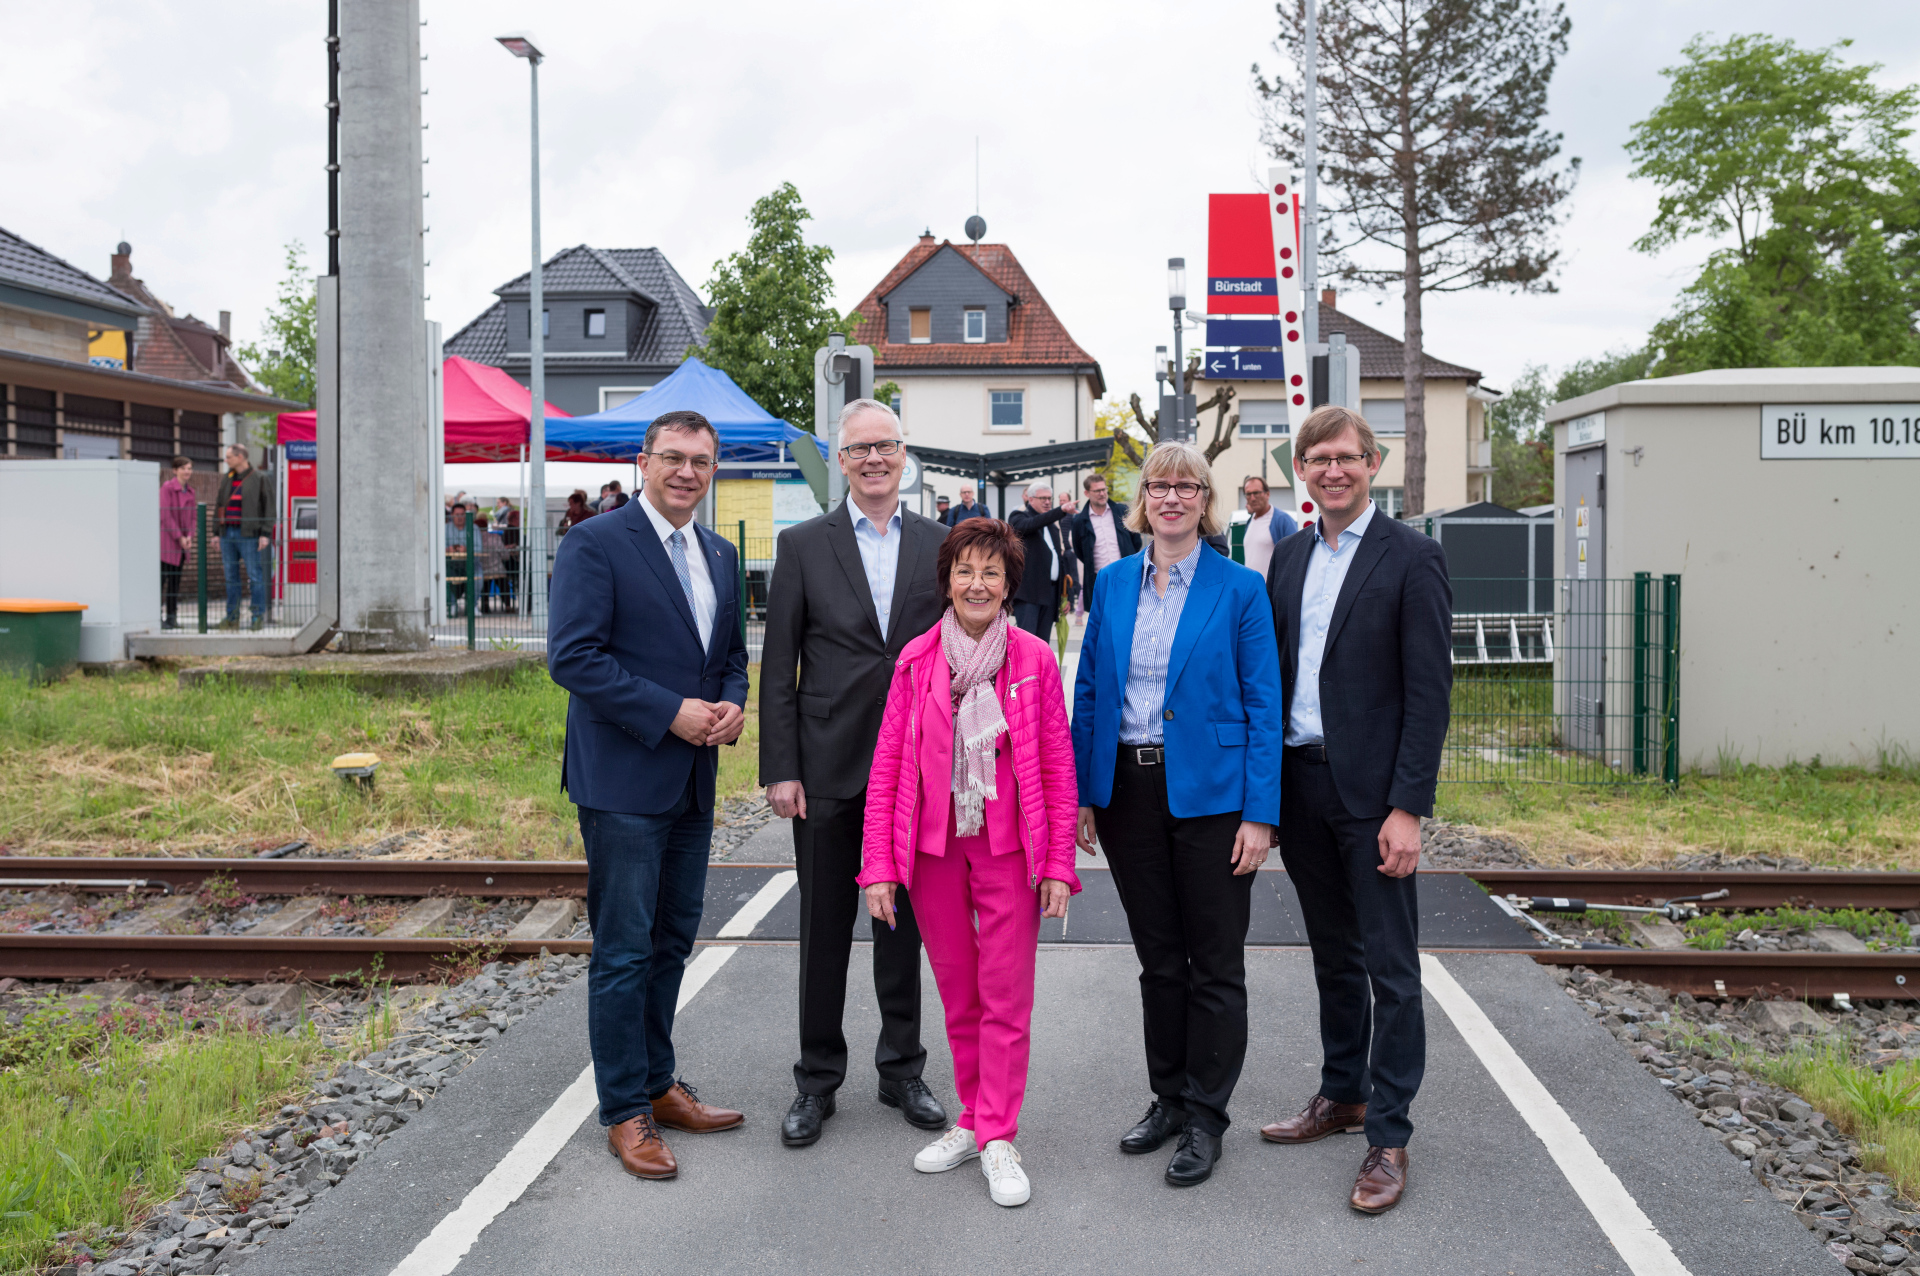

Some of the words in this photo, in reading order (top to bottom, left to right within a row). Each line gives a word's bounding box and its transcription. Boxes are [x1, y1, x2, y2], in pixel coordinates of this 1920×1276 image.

[1214, 280, 1263, 292] Bürstadt
[1231, 354, 1240, 371] 1
[1242, 363, 1262, 371] unten
[1777, 412, 1807, 445] BÜ
[1820, 418, 1855, 445] km
[752, 471, 792, 479] Information
